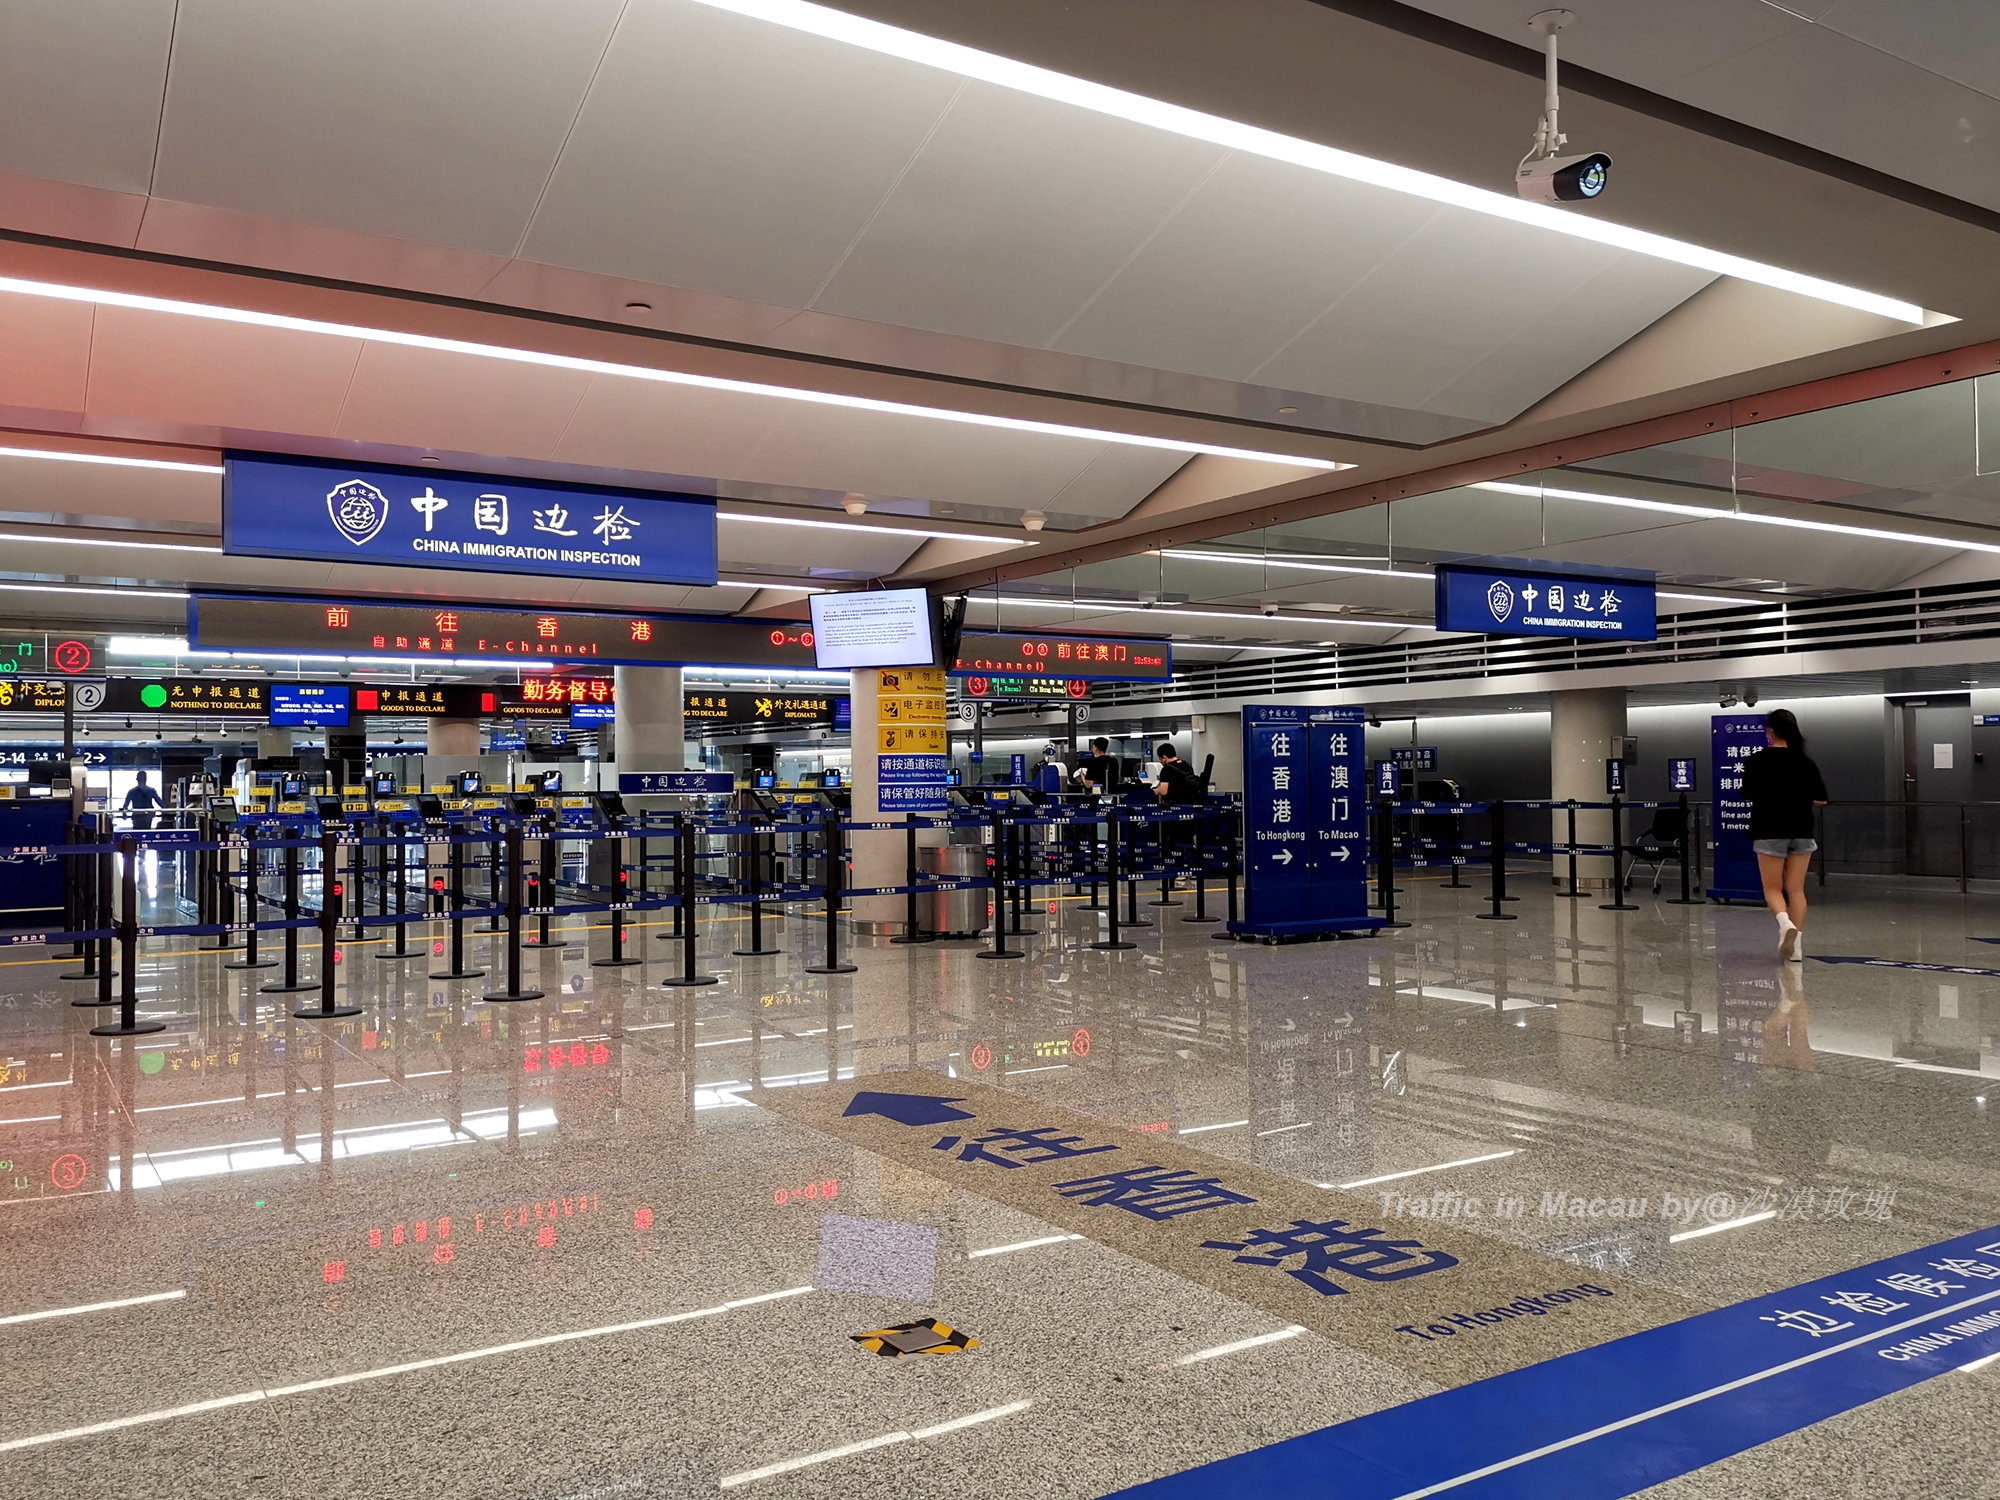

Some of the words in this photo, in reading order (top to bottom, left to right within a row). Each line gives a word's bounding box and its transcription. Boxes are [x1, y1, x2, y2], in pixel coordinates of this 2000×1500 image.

[410, 486, 640, 546] 中国边检
[413, 538, 460, 554] CHINA
[463, 542, 557, 561] IMMIGRATION
[560, 549, 641, 567] INSPECTION
[1521, 583, 1622, 617] 中国边检
[327, 607, 651, 641] 前往香港
[1523, 617, 1543, 626] CHINA
[1544, 618, 1585, 628] IMMIGRATION
[1586, 621, 1622, 630] INSPECTION
[373, 636, 453, 650] 自助通道
[1057, 643, 1127, 661] 前往澳门
[0, 659, 18, 672] o)
[20, 682, 66, 697] 外交
[171, 685, 260, 698] 无申报通道
[381, 690, 444, 702] 申报通道
[171, 701, 209, 709] NOTHING
[211, 701, 222, 709] TO
[224, 701, 261, 710] DECLARE
[415, 705, 446, 713] DECLARE
[684, 697, 728, 708] 报通道
[774, 699, 828, 710] 外交礼遇通道
[1721, 762, 1745, 773] 一米
[642, 776, 707, 787] 中国边检
[1271, 733, 1291, 823] 往香港
[1330, 733, 1349, 821] 往澳门
[1721, 800, 1745, 808] Please
[1737, 811, 1751, 819] and
[1256, 831, 1266, 840] To
[1267, 830, 1306, 842] Hongkong
[1319, 830, 1329, 839] To
[1331, 830, 1359, 839] Macao
[931, 1127, 1459, 1296] 往香港
[1395, 1325, 1456, 1340] To
[1441, 1283, 1613, 1329] Hongkong
[1878, 1332, 1963, 1361] CHINA
